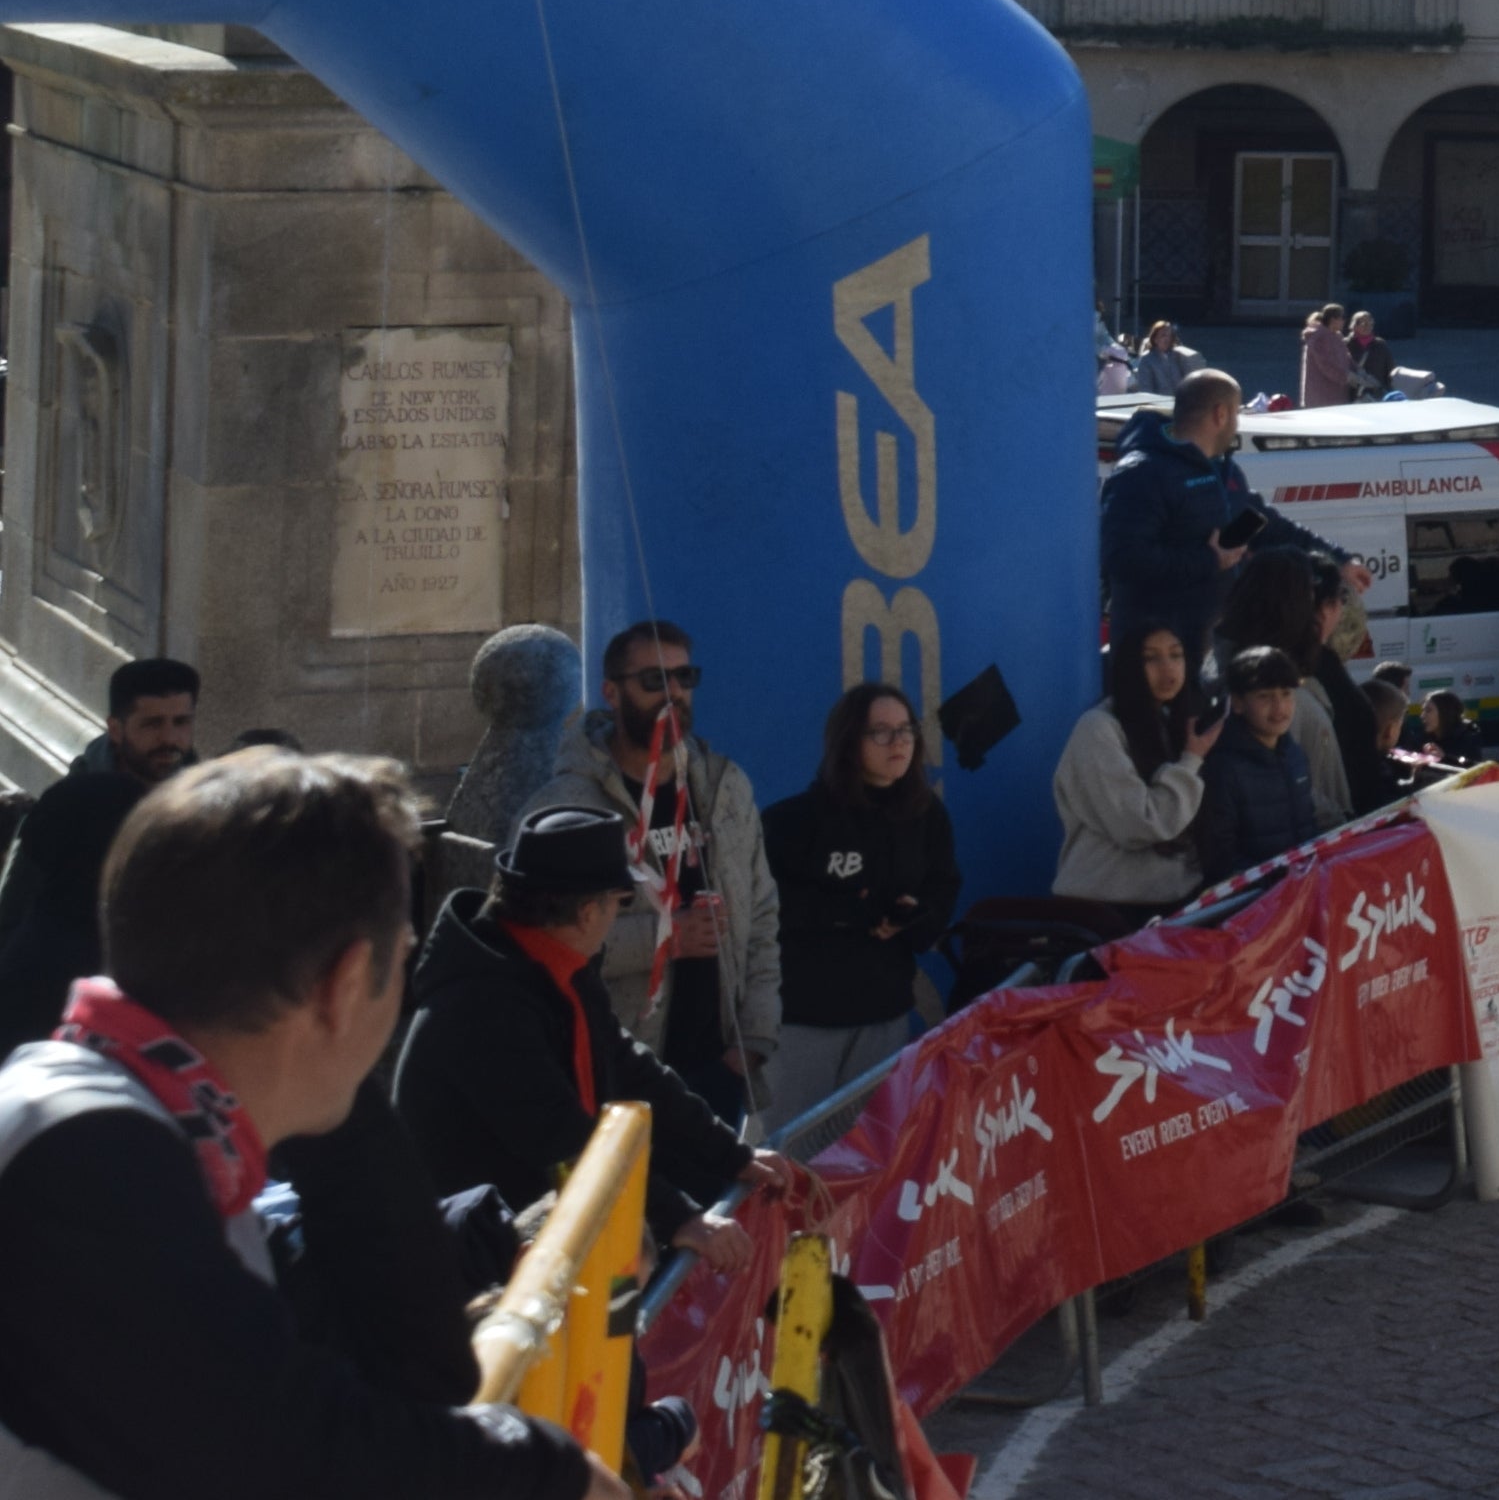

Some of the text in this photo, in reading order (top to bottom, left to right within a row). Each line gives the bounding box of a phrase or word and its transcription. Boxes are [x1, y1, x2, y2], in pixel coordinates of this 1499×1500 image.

[346, 360, 506, 381] CARLOS RUMSEY
[371, 389, 481, 408] DE NEW YORK
[354, 406, 497, 424] ESTADOS UNIDOS
[403, 434, 425, 449] LA
[431, 432, 505, 448] ESTATUA
[341, 479, 504, 502] LA SEÑORA RUMSEY
[1362, 476, 1484, 499] AMBULANCIA
[386, 506, 459, 522] LA DONO
[355, 526, 487, 545] A LA CIUDAD DE
[382, 544, 461, 561] TRUJILLO
[380, 573, 460, 593] AÑO 1927
[828, 851, 863, 879] RB
[1340, 872, 1438, 972] Spiuk
[1463, 926, 1491, 946] TB
[1092, 1017, 1233, 1124] Spiuk
[974, 1073, 1054, 1186] Spiuk
[1119, 1125, 1157, 1161] EVERY
[1197, 1098, 1229, 1131] EVERY
